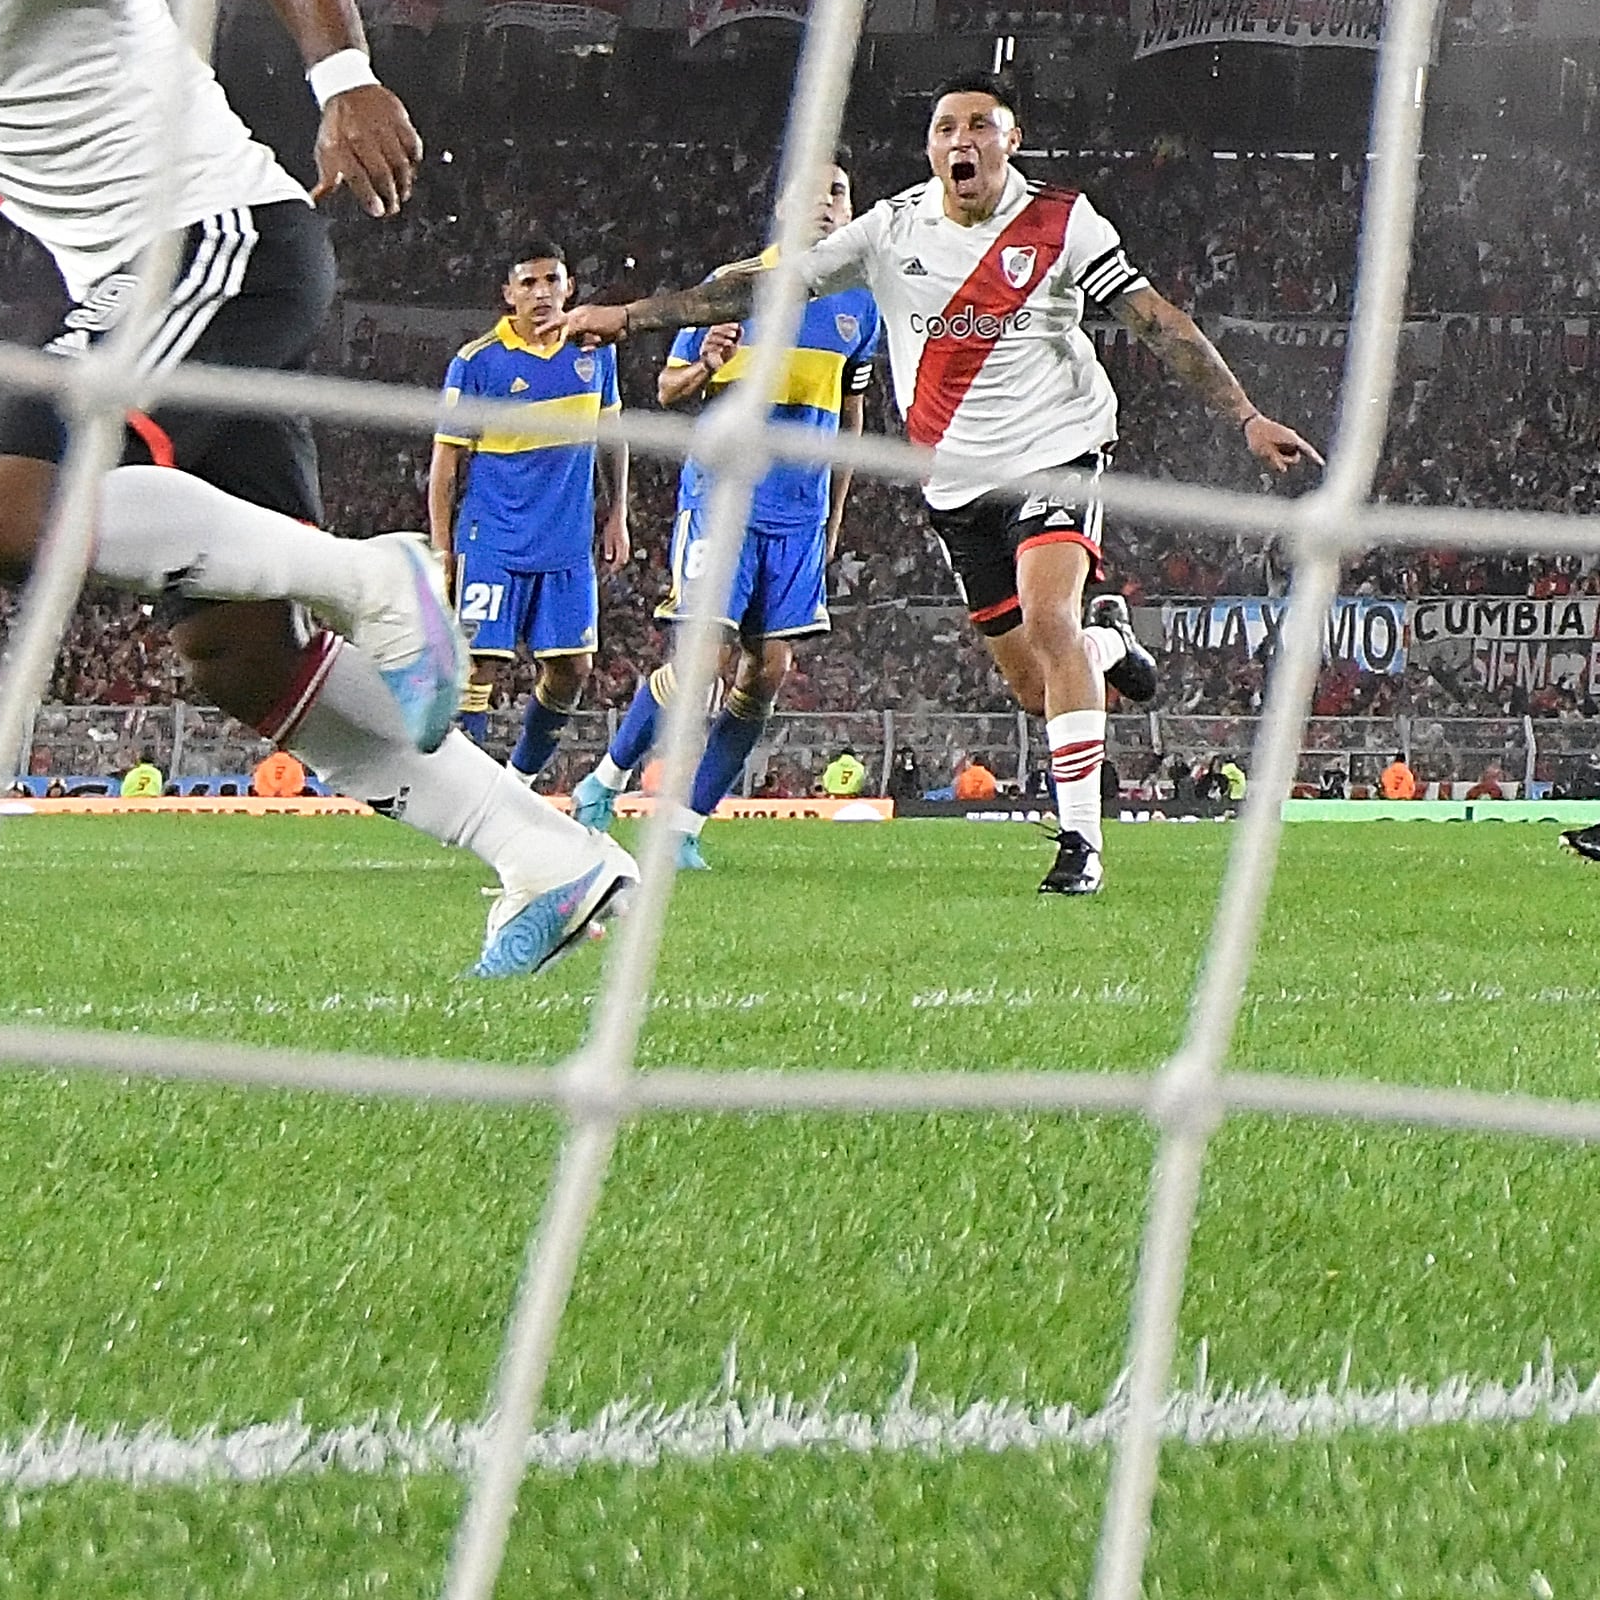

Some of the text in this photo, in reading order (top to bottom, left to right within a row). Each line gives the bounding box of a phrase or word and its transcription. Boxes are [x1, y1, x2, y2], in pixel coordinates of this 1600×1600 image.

[909, 304, 1032, 339] codere
[461, 582, 504, 621] 21
[1162, 603, 1398, 671] MAXMO
[1413, 602, 1586, 641] CUMBIA
